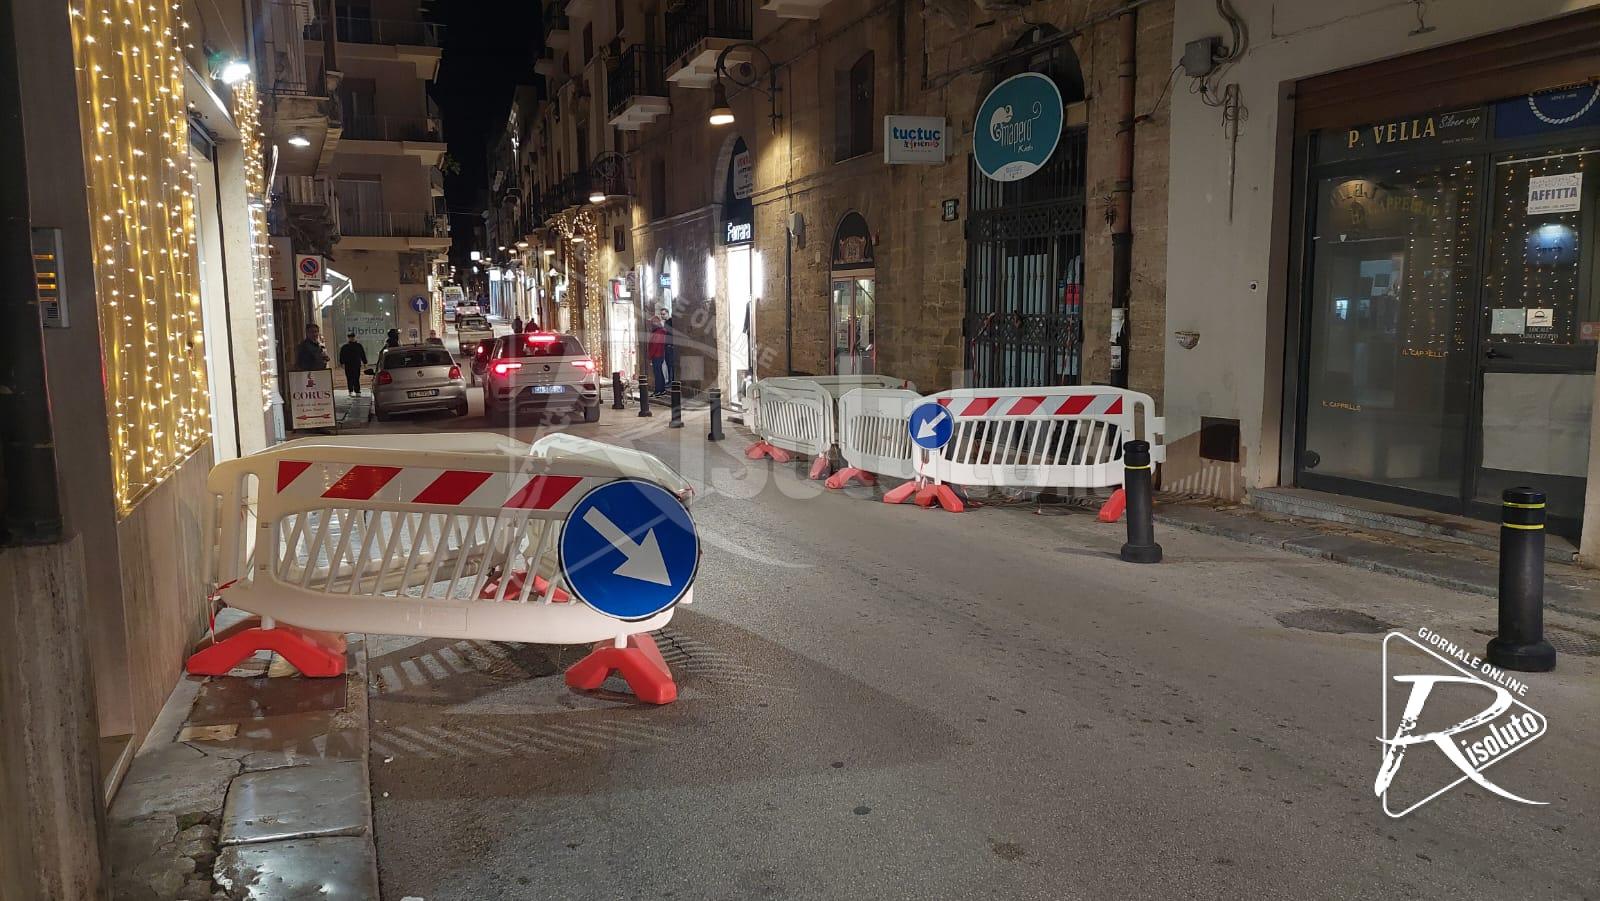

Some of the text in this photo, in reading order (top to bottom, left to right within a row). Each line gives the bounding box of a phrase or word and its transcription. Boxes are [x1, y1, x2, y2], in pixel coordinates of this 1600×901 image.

[893, 126, 941, 141] tuctuc
[1348, 117, 1436, 149] P. VELLA
[1530, 186, 1578, 202] AFFITTA
[347, 326, 385, 335] Hibrido
[293, 391, 331, 401] CORUS
